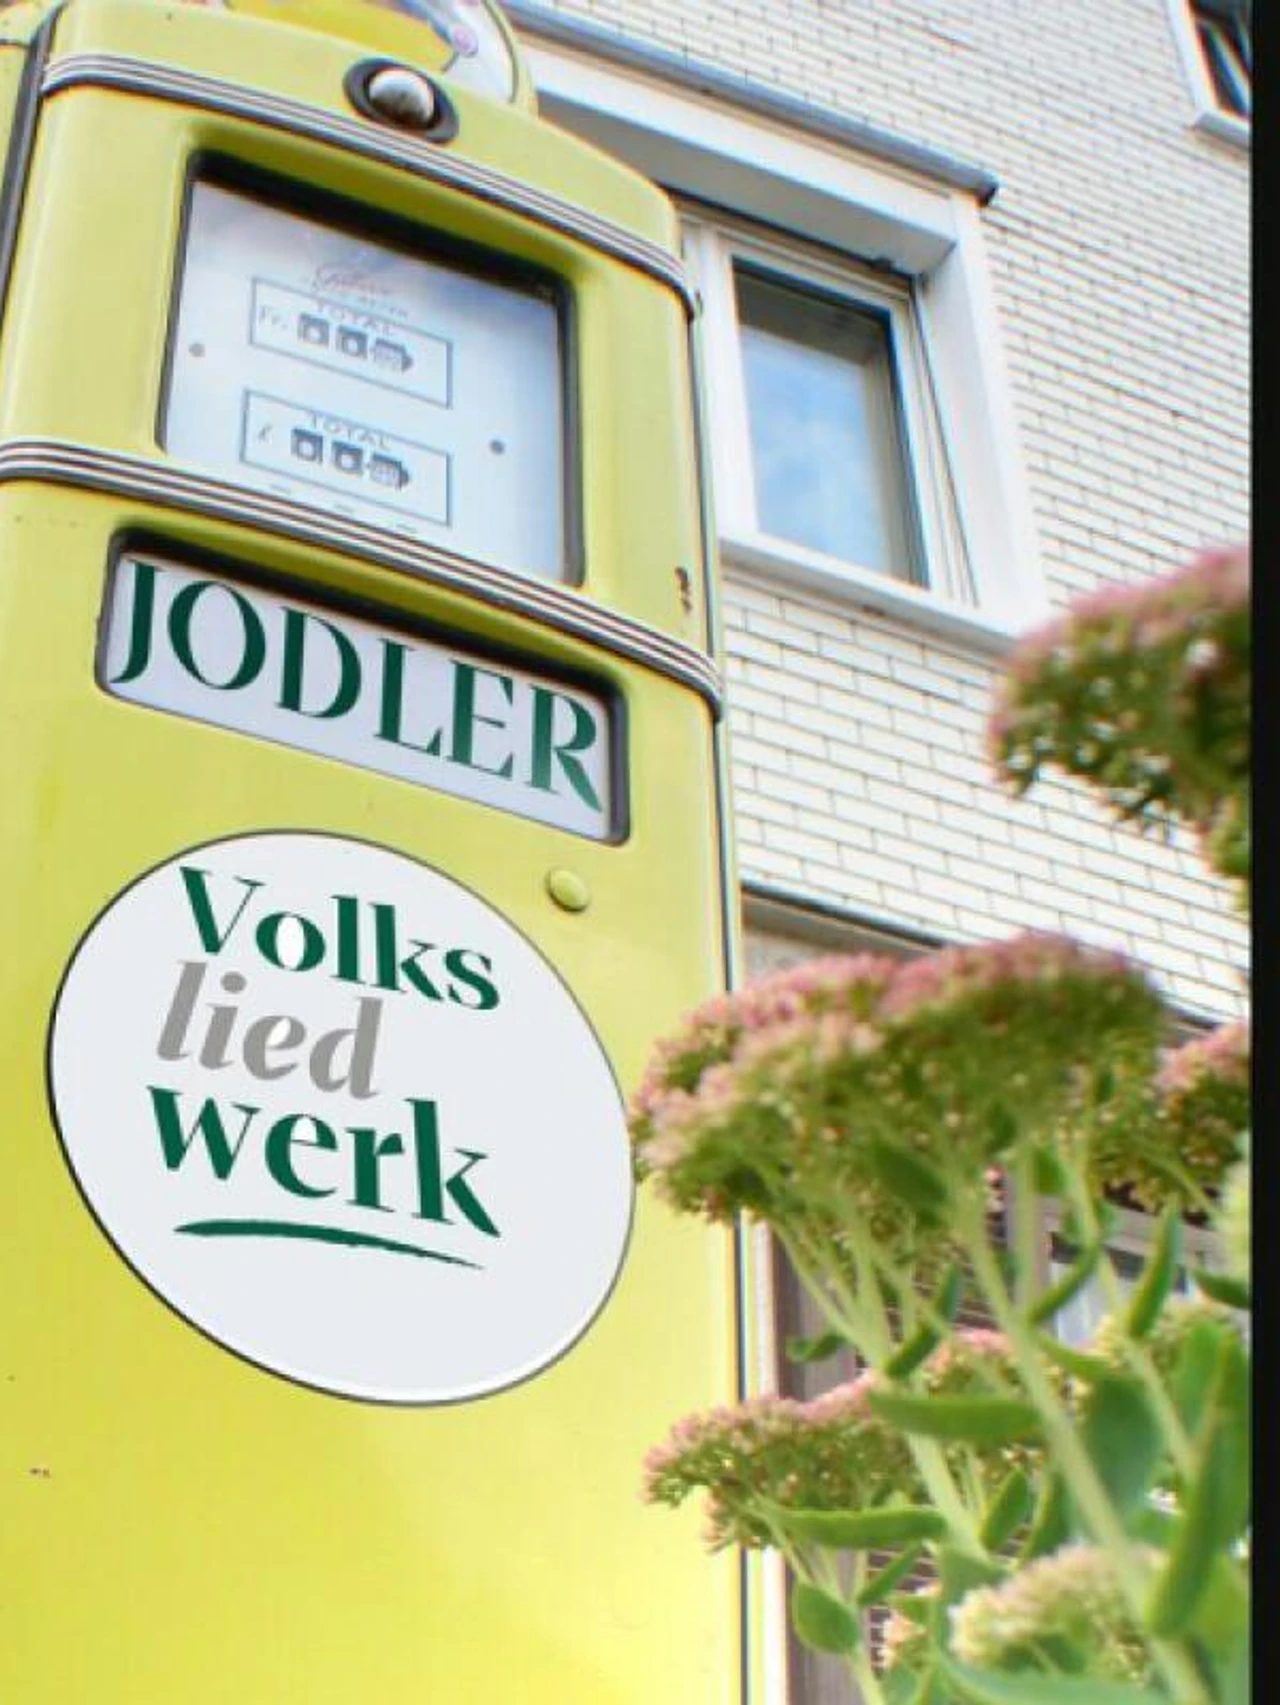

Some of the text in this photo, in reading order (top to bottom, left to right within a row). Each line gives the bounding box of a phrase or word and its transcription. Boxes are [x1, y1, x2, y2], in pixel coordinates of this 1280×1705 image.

[307, 408, 393, 450] TOTAL
[110, 559, 603, 813] JODLER
[180, 866, 500, 1011] Volks
[156, 960, 384, 1099] lied
[146, 1085, 501, 1238] werk
